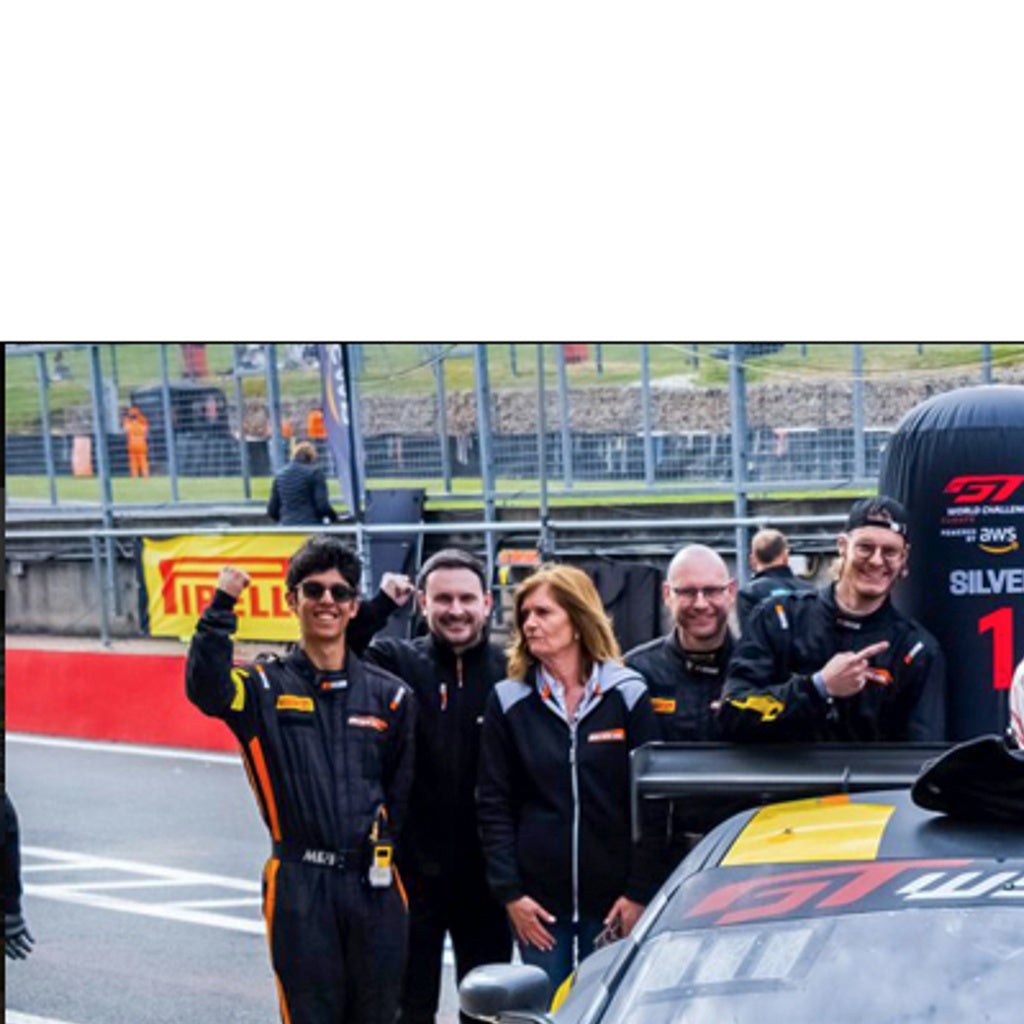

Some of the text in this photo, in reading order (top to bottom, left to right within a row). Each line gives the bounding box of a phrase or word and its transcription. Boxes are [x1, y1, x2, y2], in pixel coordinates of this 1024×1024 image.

[980, 526, 1018, 542] aws
[977, 606, 1014, 690] 1
[683, 859, 975, 925] GT
